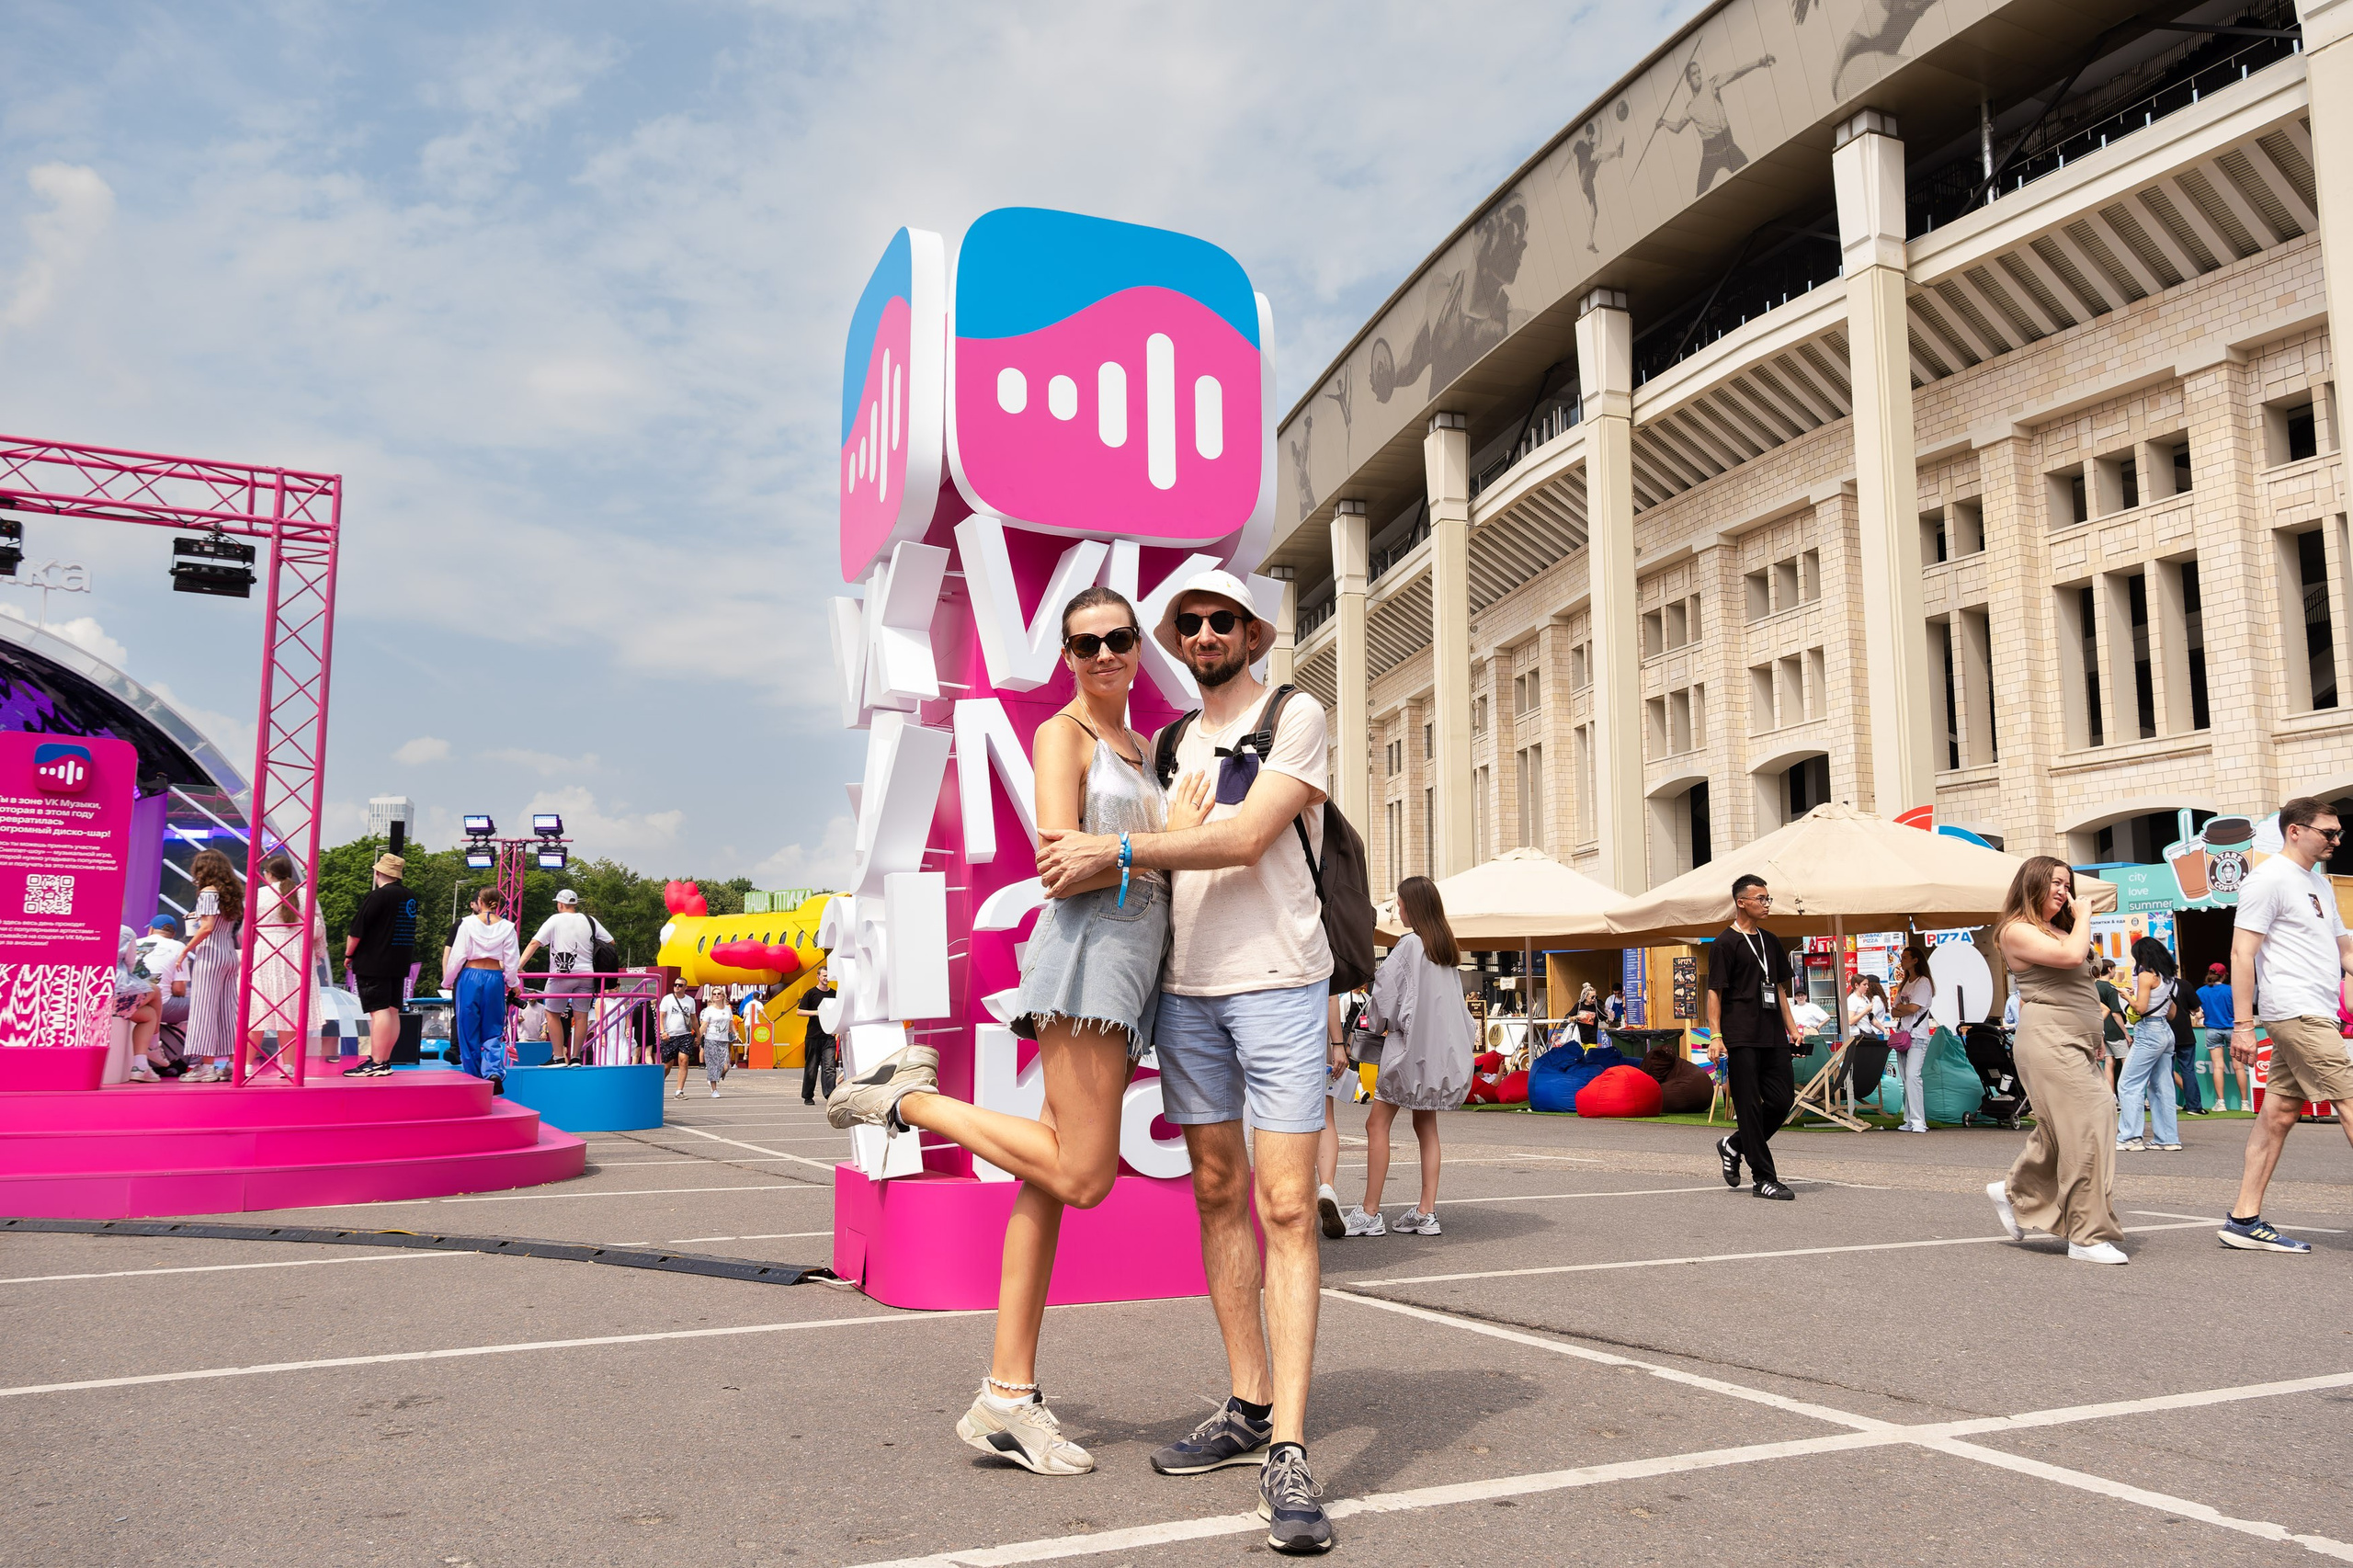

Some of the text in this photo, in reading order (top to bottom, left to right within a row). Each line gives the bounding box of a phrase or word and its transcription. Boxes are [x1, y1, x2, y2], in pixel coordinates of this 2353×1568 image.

[17, 555, 92, 593] ка
[44, 798, 59, 806] VK
[60, 799, 101, 810] Музыки,
[72, 811, 95, 819] году
[52, 828, 111, 838] диско-шар!
[2214, 852, 2244, 864] STARS
[2128, 872, 2147, 882] city
[2128, 887, 2149, 896] love
[745, 892, 770, 913] НАША
[2129, 900, 2173, 911] summer
[17, 964, 116, 983] МУЗЫКА
